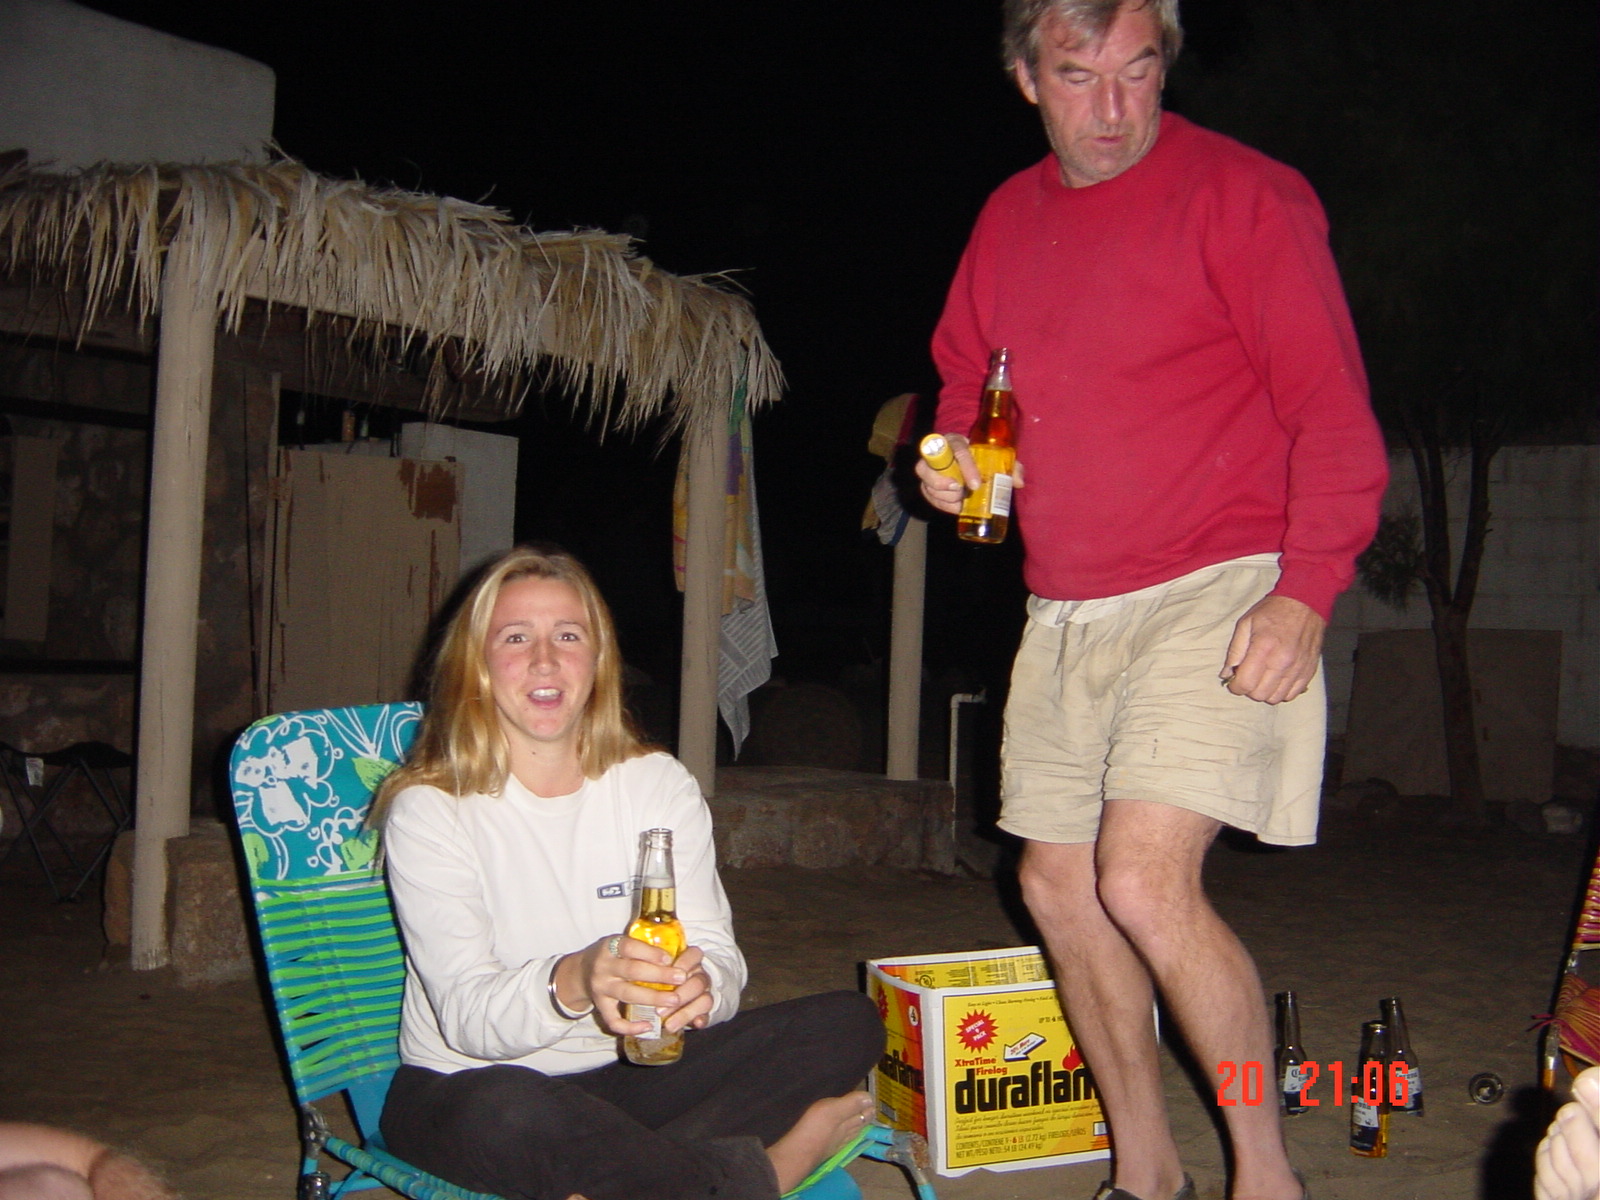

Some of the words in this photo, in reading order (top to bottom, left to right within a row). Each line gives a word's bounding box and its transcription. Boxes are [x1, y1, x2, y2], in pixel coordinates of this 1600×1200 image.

[965, 1019, 985, 1033] SPECIAL
[972, 1030, 987, 1041] PACK
[955, 1057, 997, 1067] XtraTime
[976, 1066, 1008, 1075] Firelog
[954, 1060, 1099, 1114] duraflam
